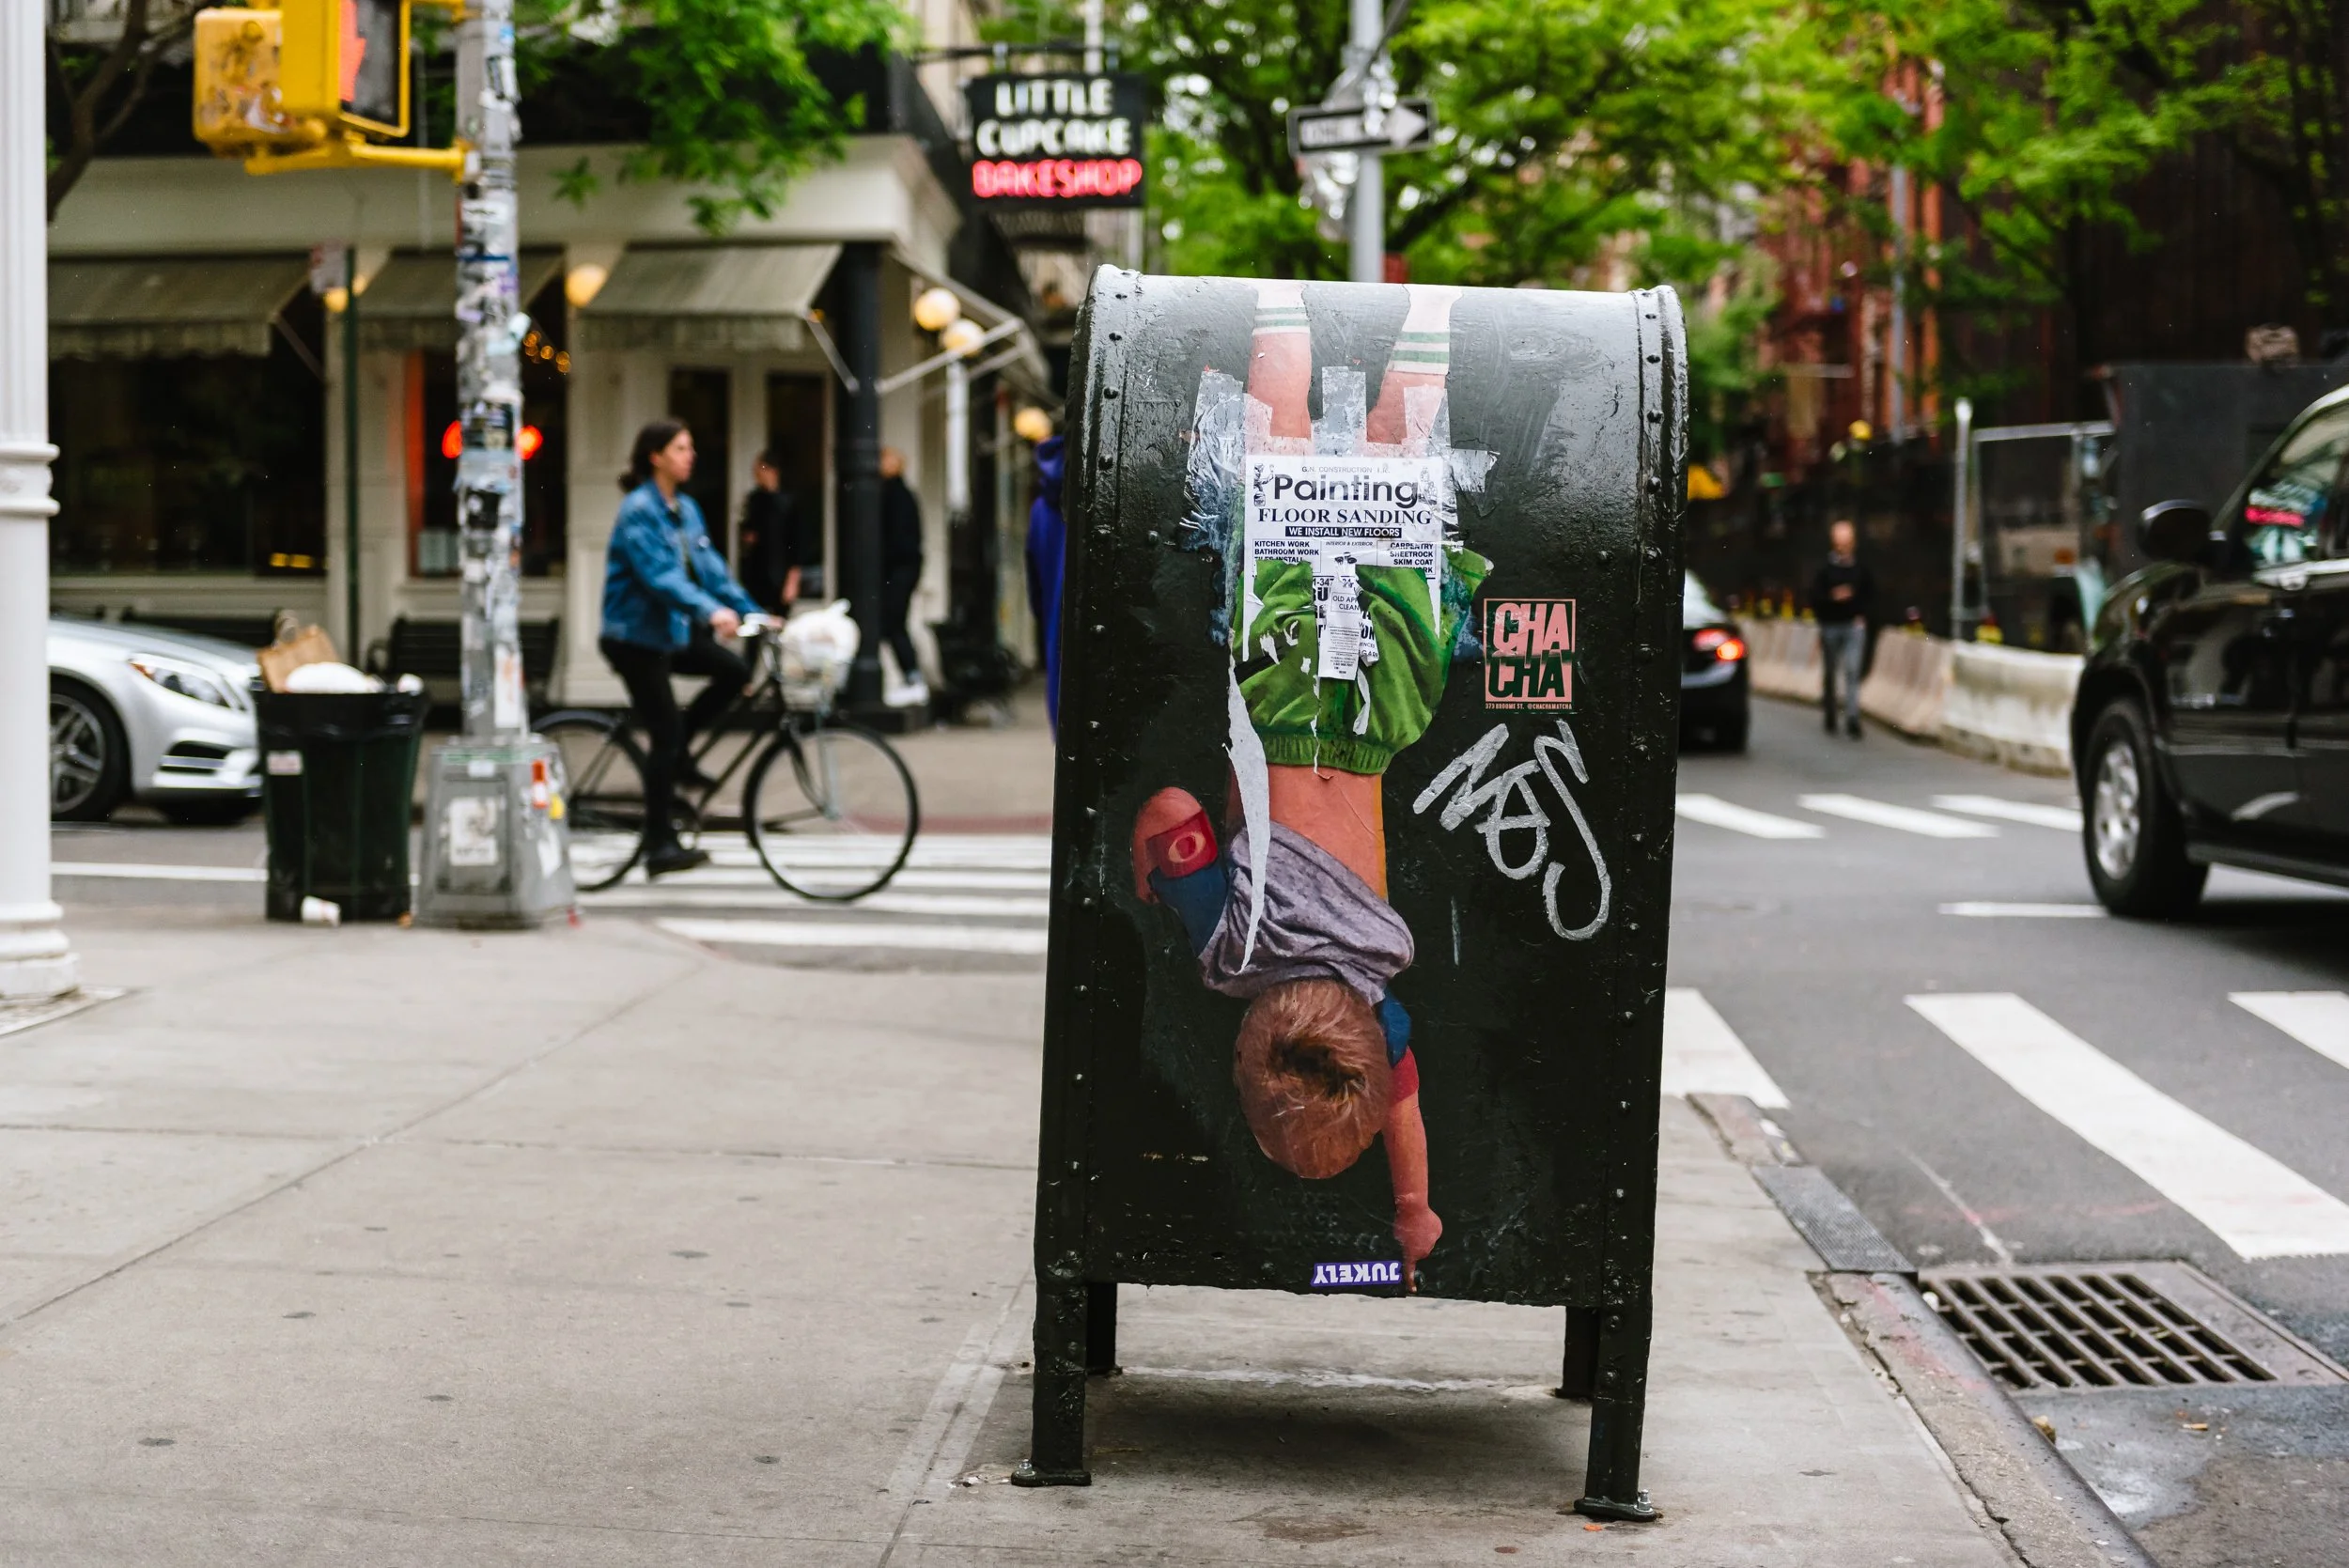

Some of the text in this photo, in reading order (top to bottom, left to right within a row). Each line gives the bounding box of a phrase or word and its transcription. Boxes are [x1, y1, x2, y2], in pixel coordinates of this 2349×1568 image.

[996, 79, 1112, 116] LITTLE
[977, 118, 1130, 156] CUPCAKE
[1274, 474, 1419, 508] Painting
[1258, 508, 1432, 525] FLOOR SANDING
[1288, 527, 1400, 536] WE INSTALL NEW FLOORS
[1492, 602, 1571, 656] CHA
[1488, 655, 1566, 698] CHA
[1314, 1262, 1400, 1284] JUKELY
